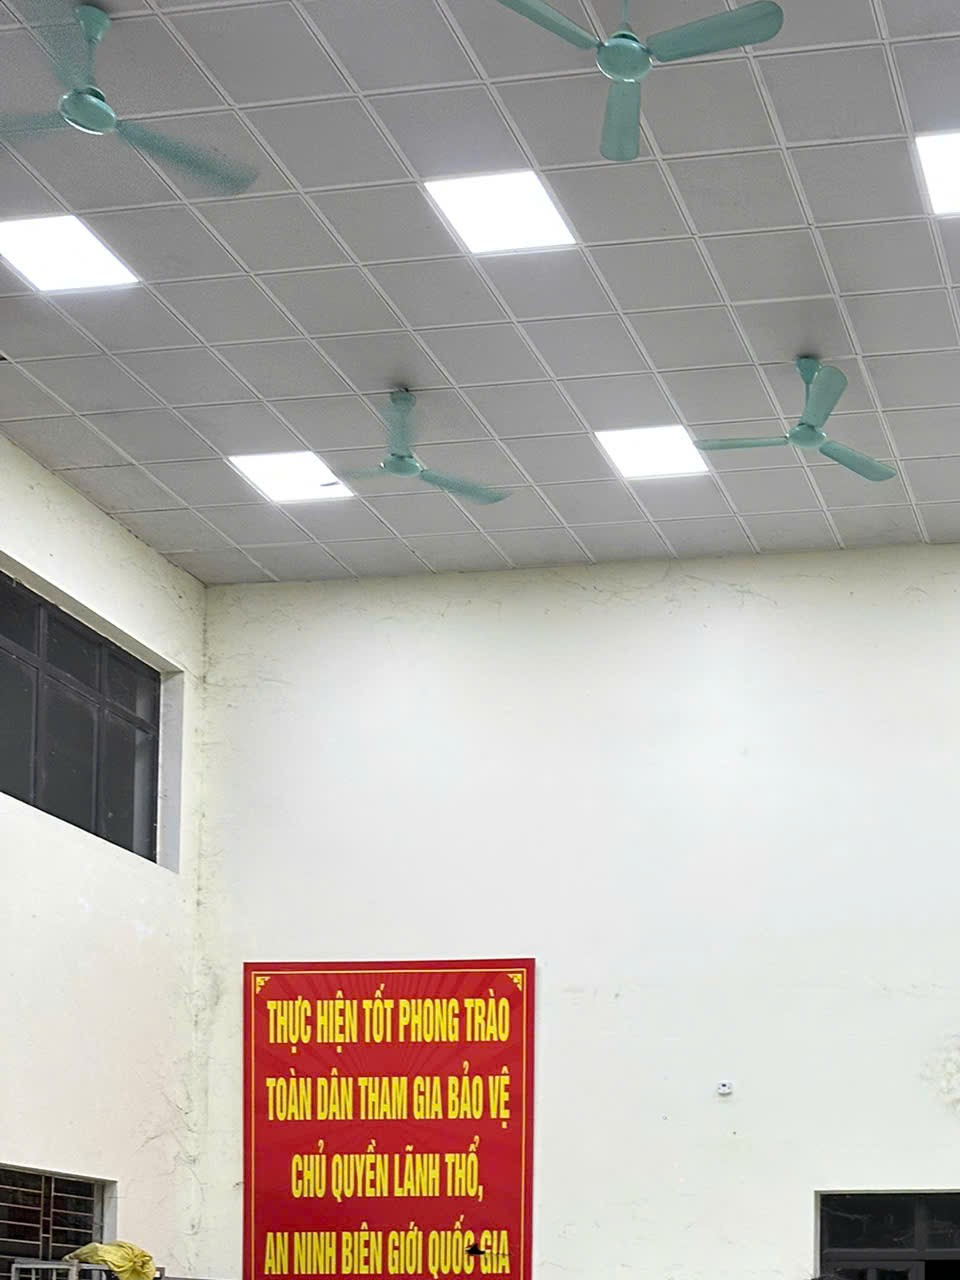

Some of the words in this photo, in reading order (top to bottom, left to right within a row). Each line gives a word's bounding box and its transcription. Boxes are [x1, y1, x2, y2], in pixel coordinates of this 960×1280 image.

[267, 996, 311, 1053] THỰC
[317, 990, 357, 1053] HIỆN
[363, 984, 394, 1043] TỐT
[399, 998, 459, 1042] PHONG
[464, 989, 509, 1041] TRÀO
[266, 1068, 311, 1121] TOÀN
[317, 1068, 353, 1120] DÂN
[358, 1077, 407, 1120] THAM
[413, 1076, 443, 1120] GIA
[448, 1061, 483, 1119] BẢO
[488, 1066, 510, 1128] VỆ
[292, 1140, 326, 1198] CHỦ
[332, 1139, 388, 1202] QUYỀN
[394, 1145, 439, 1196] LÃNH
[445, 1136, 483, 1201] THỔ,
[265, 1232, 288, 1274] AN
[294, 1232, 336, 1274] NINH
[342, 1222, 382, 1274] BIÊN
[388, 1222, 422, 1274] GIỚI
[428, 1215, 474, 1279] QUỐC
[480, 1230, 510, 1274] GIA
